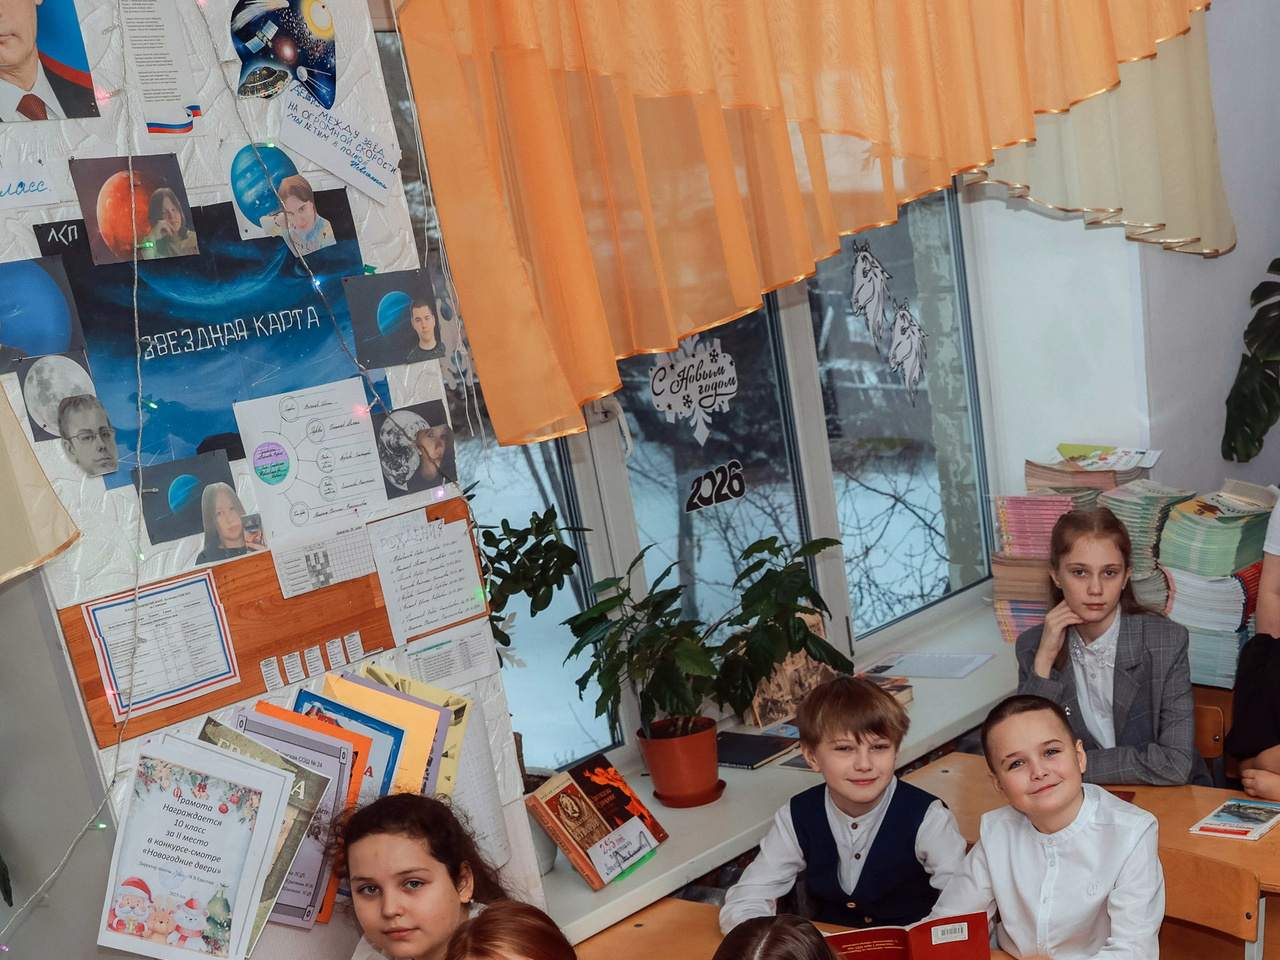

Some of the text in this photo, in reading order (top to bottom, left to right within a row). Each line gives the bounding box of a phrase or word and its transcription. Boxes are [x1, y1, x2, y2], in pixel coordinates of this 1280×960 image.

[141, 306, 320, 360] ЗВЕЗДНАЯ КАРТА
[652, 359, 726, 396] С Новым
[698, 376, 738, 409] годом
[684, 458, 747, 514] 2026
[380, 520, 444, 550] РОЖДЕНИЯ
[162, 803, 223, 827] Награждается
[176, 795, 213, 812] Грамота
[165, 830, 175, 838] за
[182, 835, 209, 847] место
[174, 819, 207, 835] 10 класс
[142, 848, 222, 875] «Новогодние двери»
[154, 839, 222, 863] конкурсе-смотре
